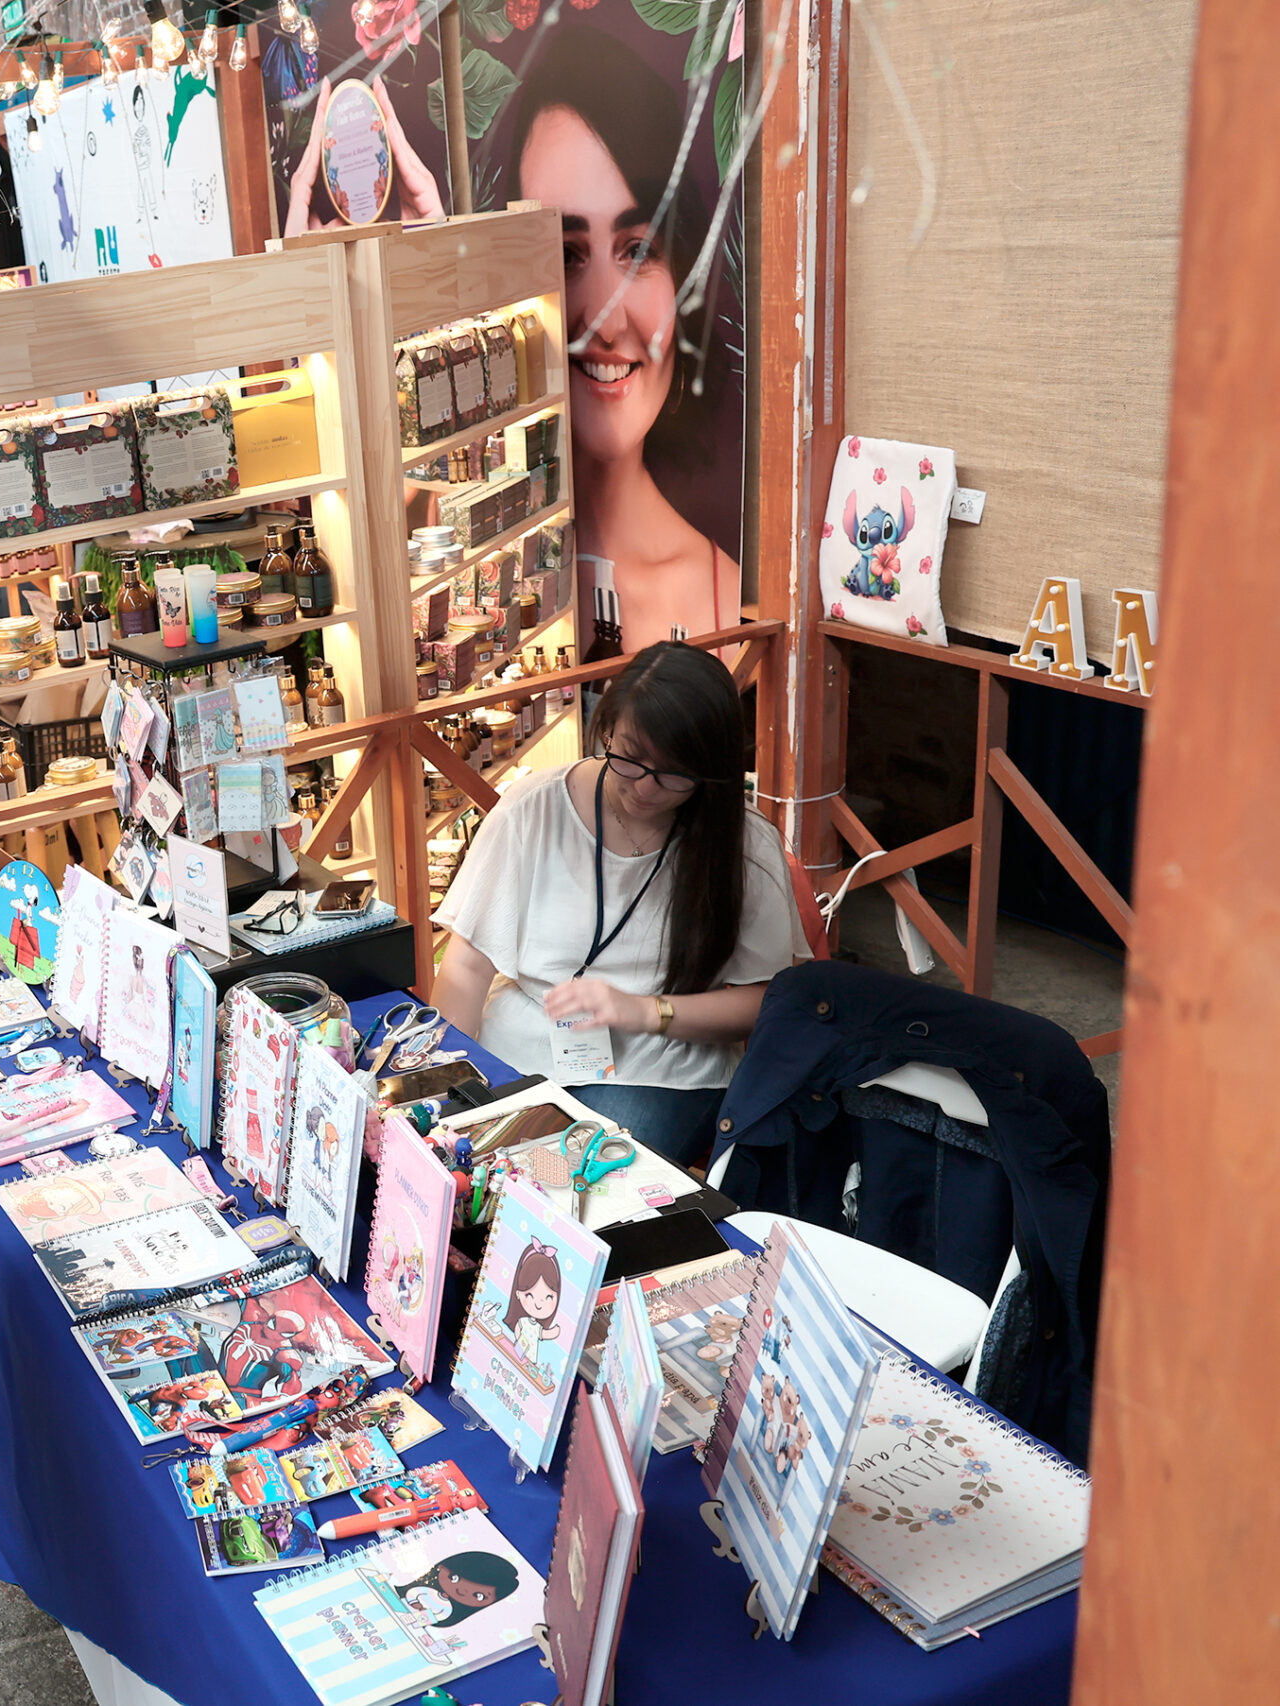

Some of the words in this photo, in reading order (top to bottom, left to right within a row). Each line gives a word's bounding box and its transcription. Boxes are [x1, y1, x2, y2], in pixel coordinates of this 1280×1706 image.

[22, 864, 35, 878] 12
[98, 1170, 131, 1202] Retas
[126, 1172, 146, 1188] Mis
[483, 1372, 526, 1422] planner
[491, 1357, 530, 1401] crafter
[845, 1451, 890, 1481] am
[316, 1606, 369, 1660] planner
[342, 1601, 388, 1651] crafter
